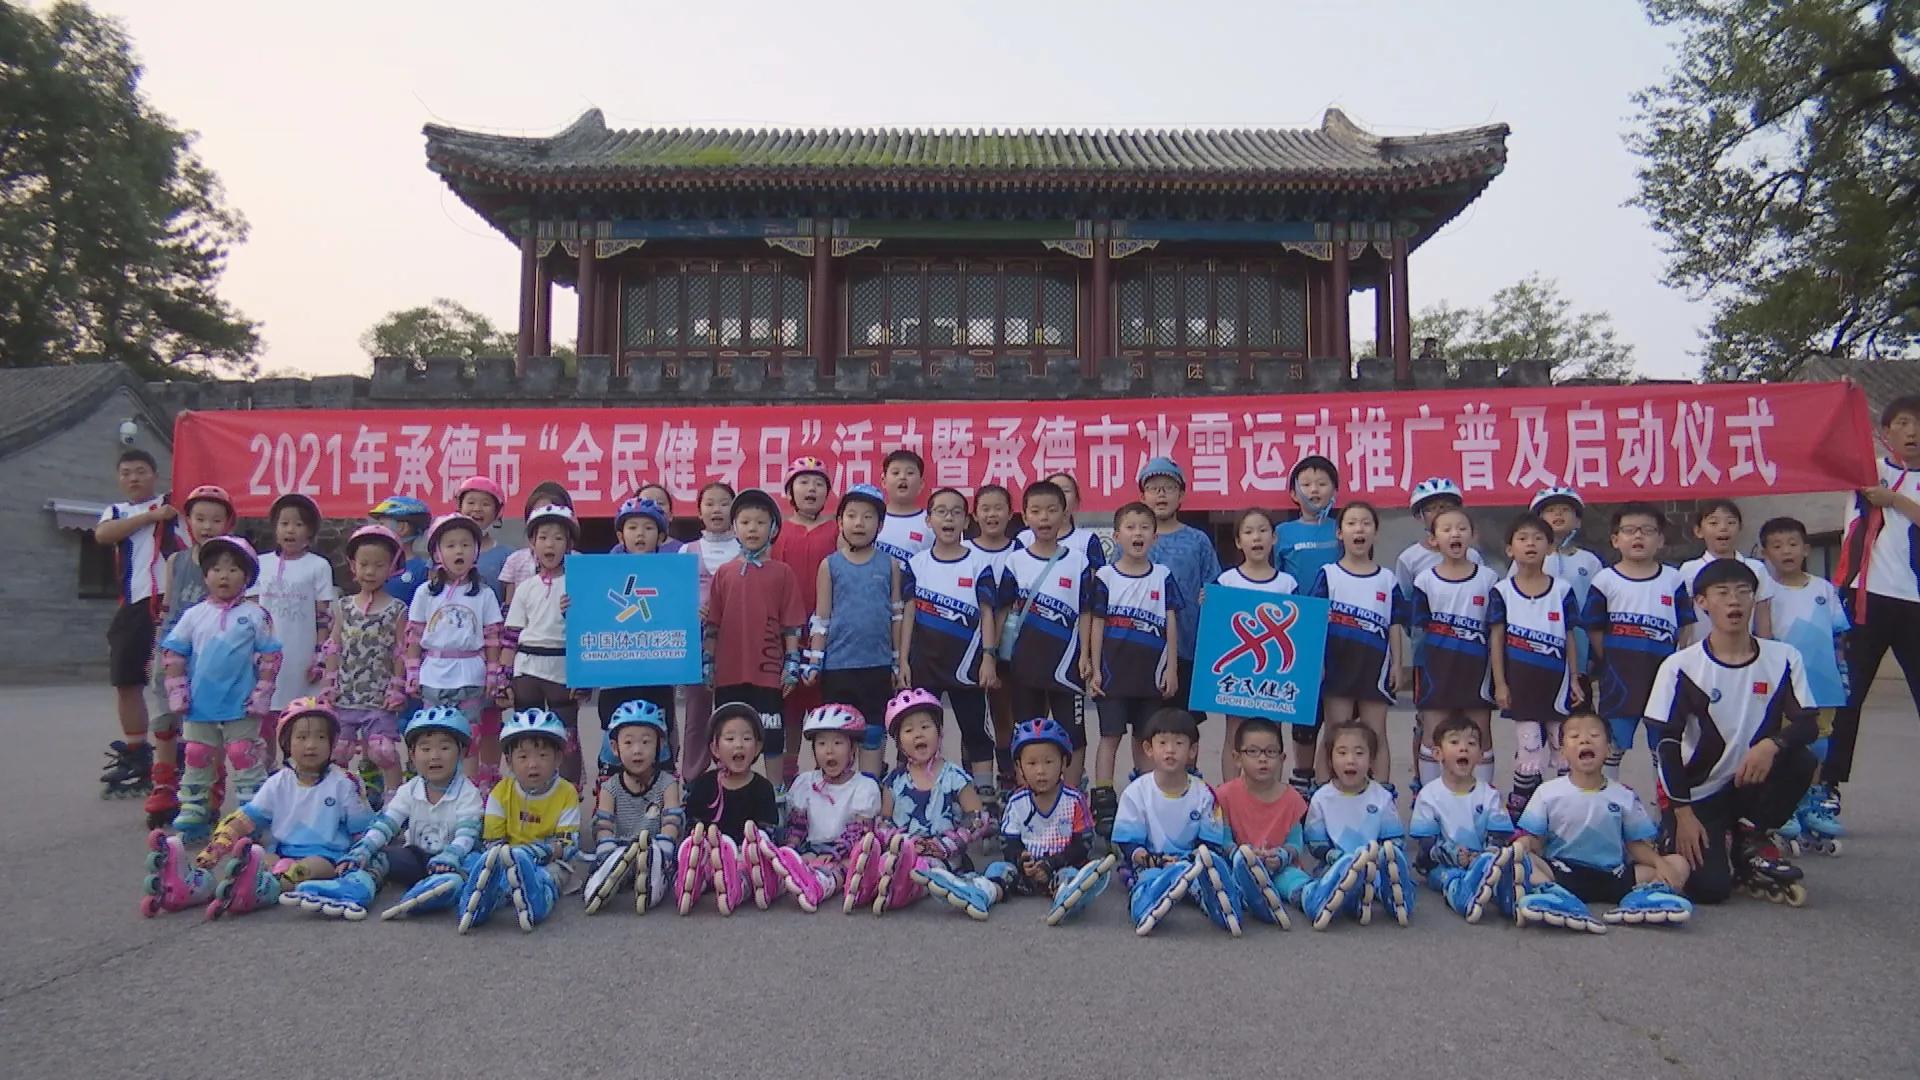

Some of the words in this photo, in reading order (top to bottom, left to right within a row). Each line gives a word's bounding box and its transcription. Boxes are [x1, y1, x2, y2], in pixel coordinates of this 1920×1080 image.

[936, 595, 976, 617] ROLLER
[1036, 593, 1073, 617] ROLLER
[581, 630, 687, 649] 中国体育彩票
[581, 651, 610, 661] CHINA
[611, 650, 646, 660] SPORTS
[647, 649, 687, 659] LOTTERY
[1217, 673, 1300, 701] 全民健身
[1215, 694, 1255, 709] SPORTS
[1255, 699, 1277, 711] FOR
[1277, 702, 1297, 714] ALL
